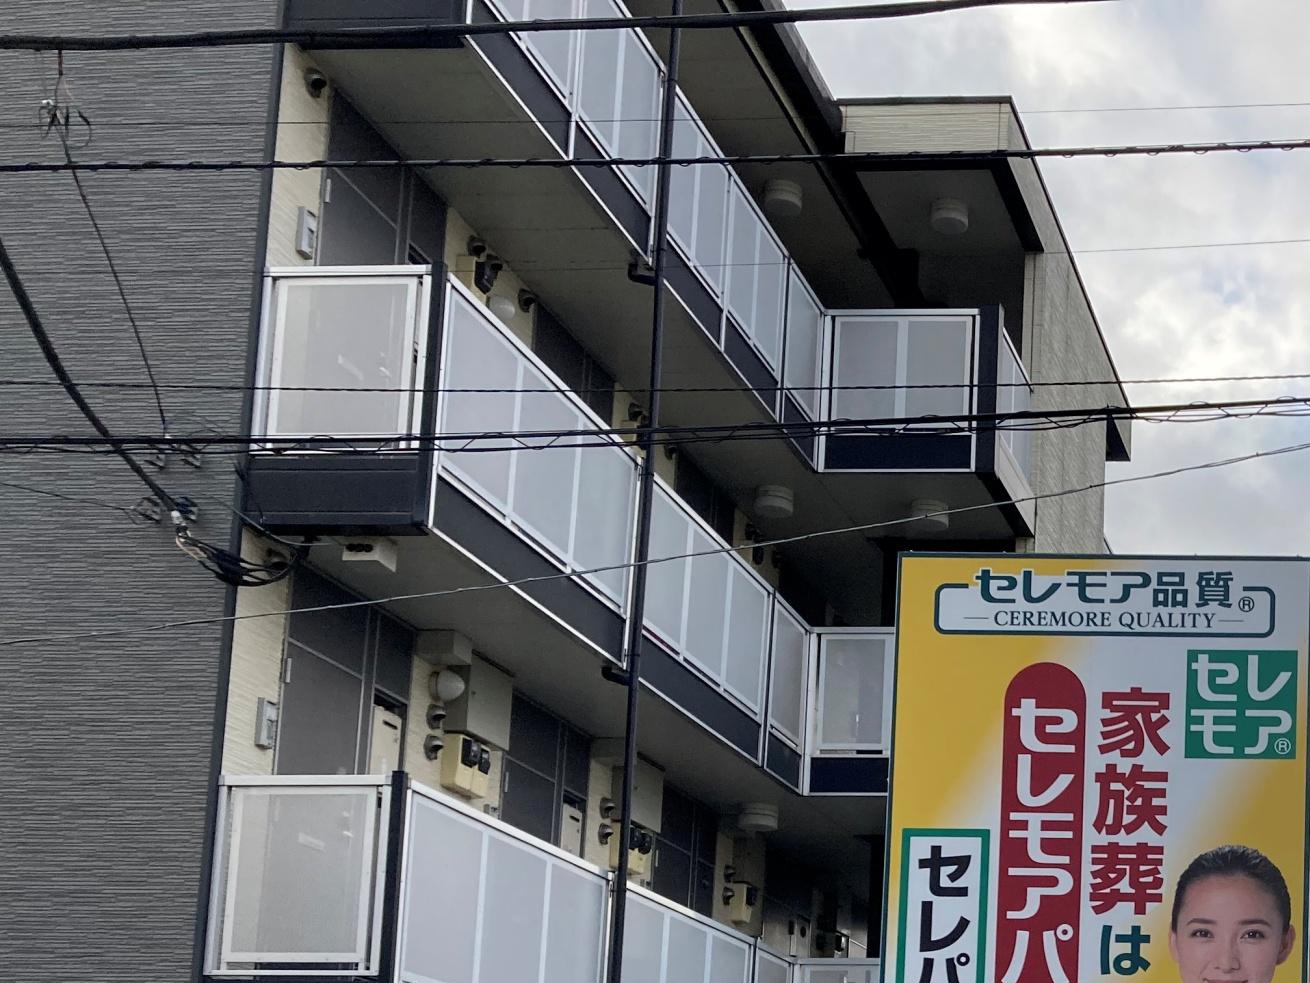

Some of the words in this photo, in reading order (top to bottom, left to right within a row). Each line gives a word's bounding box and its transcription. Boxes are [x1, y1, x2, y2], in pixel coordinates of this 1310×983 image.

[993, 610, 1112, 627] CEREMORE
[1118, 611, 1217, 629] QUALITY
[1089, 686, 1171, 976] 家族葬は
